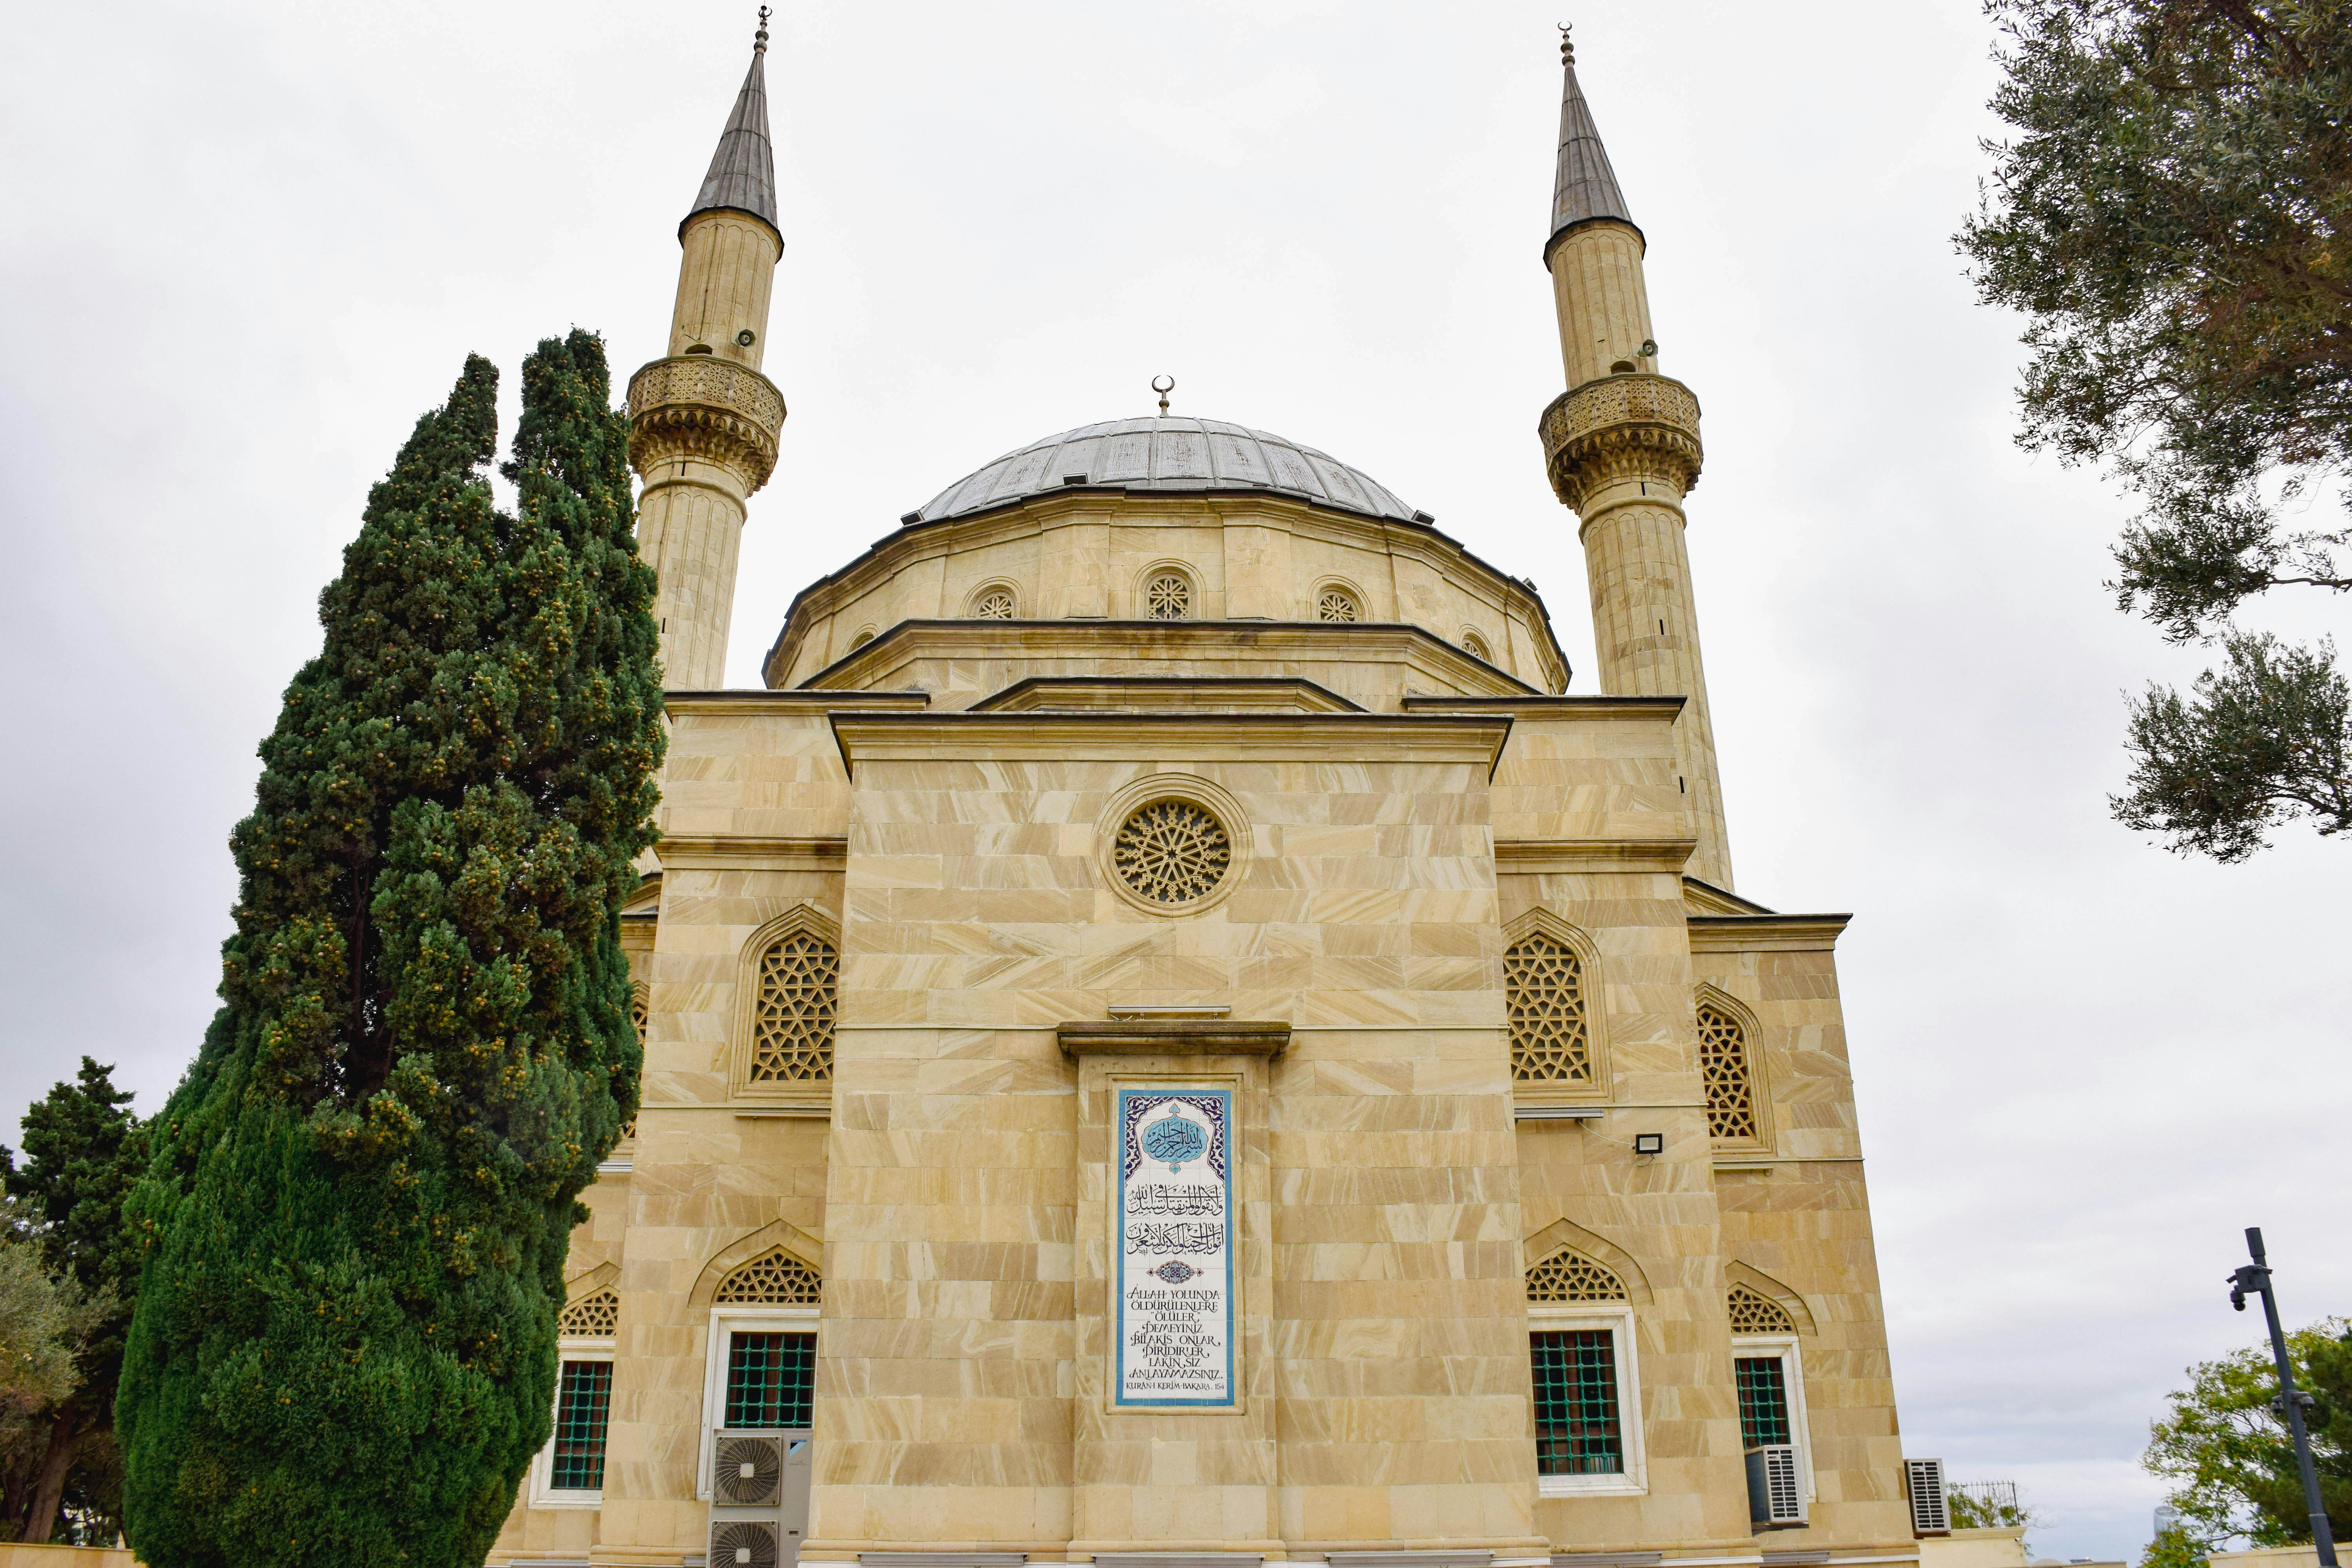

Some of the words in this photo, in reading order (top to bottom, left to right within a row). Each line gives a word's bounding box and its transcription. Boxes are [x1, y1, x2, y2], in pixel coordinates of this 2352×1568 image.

[1127, 1284, 1167, 1299] ALLAH
[1170, 1290, 1220, 1301] YOLUNDA
[1131, 1299, 1218, 1312] ÖLDÜRÜLENLERE
[1142, 1321, 1204, 1334] DEMEYİNİZ
[1131, 1331, 1172, 1346] BİLAKİS
[1186, 1356, 1201, 1367] SİZ
[1129, 1367, 1223, 1381] ANLAYAMAZSINIZ.
